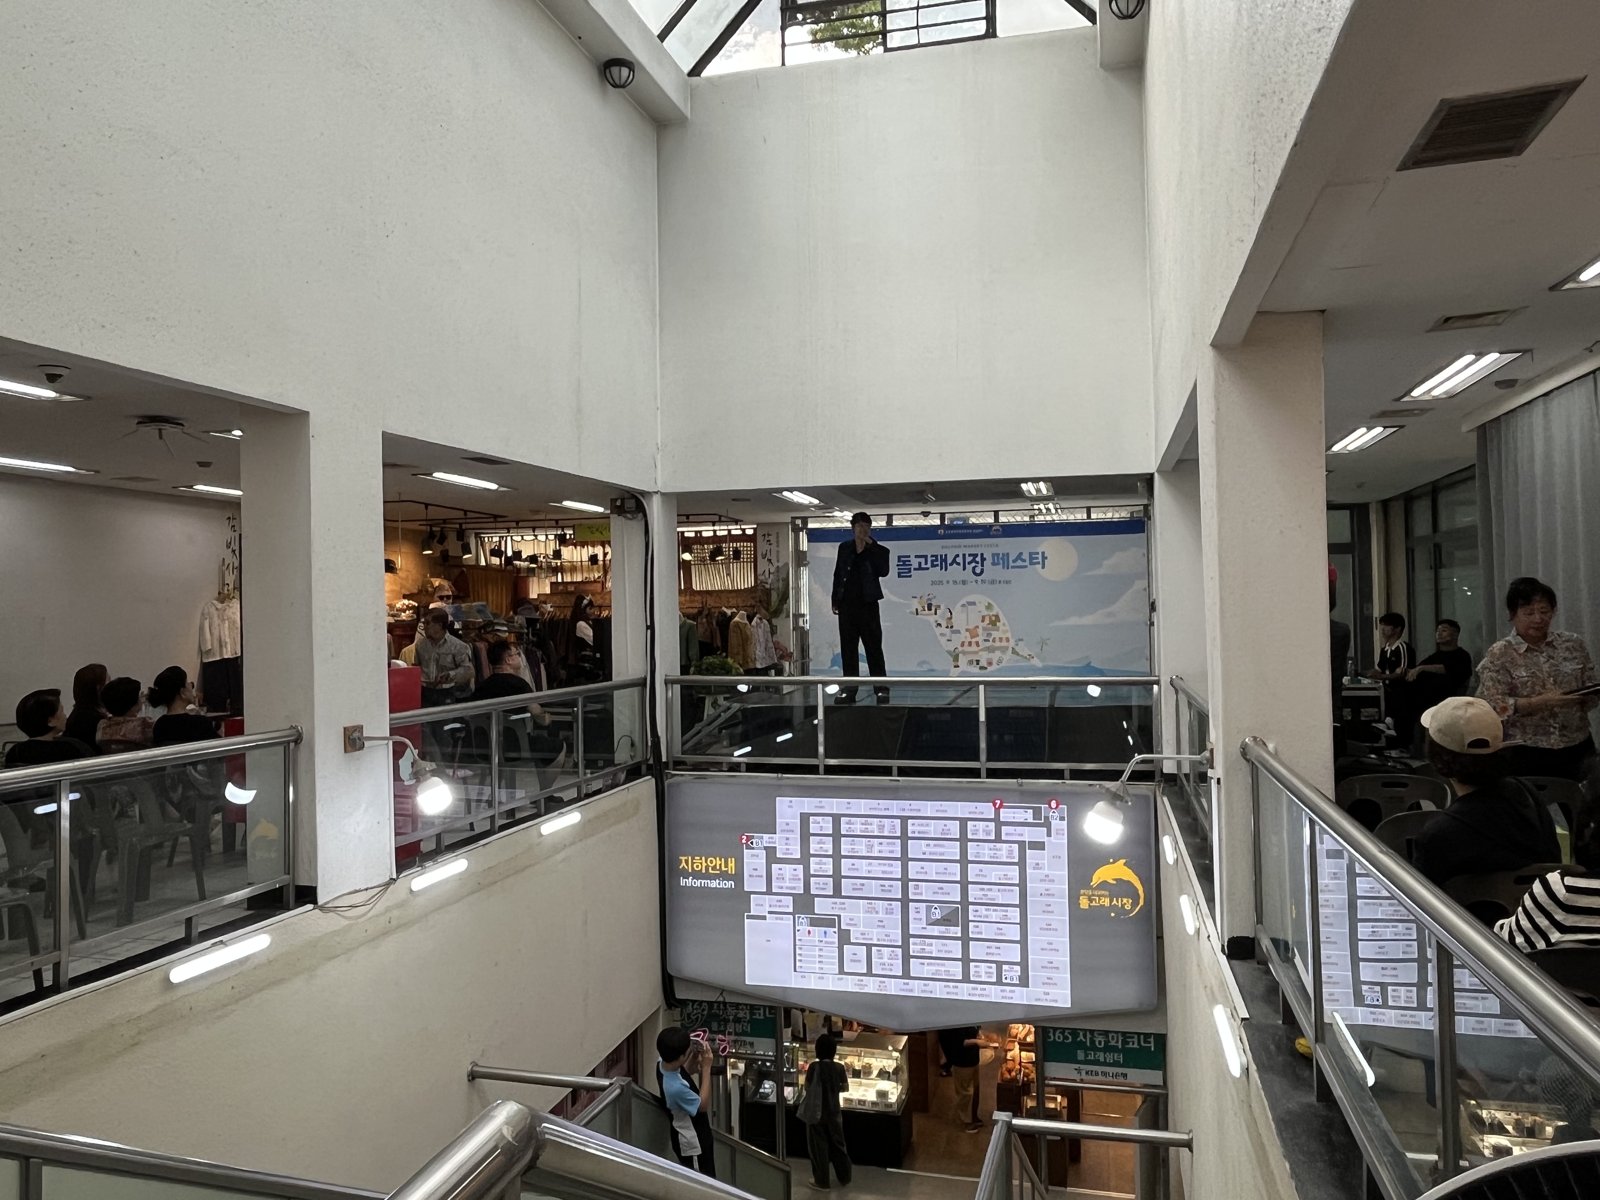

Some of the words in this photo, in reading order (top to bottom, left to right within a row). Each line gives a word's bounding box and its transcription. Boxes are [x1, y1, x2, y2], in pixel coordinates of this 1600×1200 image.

[896, 552, 987, 578] 돌고래시장
[991, 551, 1048, 570] 페스타
[995, 800, 1001, 808] 7
[741, 835, 747, 843] 2
[678, 855, 737, 875] 지하안내
[679, 876, 735, 889] Information
[1047, 1028, 1072, 1043] 365
[1076, 1030, 1155, 1051] 자동화코너
[1076, 1049, 1124, 1064] 돌고래쉼터
[1085, 1069, 1100, 1077] KEB
[1100, 1070, 1128, 1080] 하나은행
